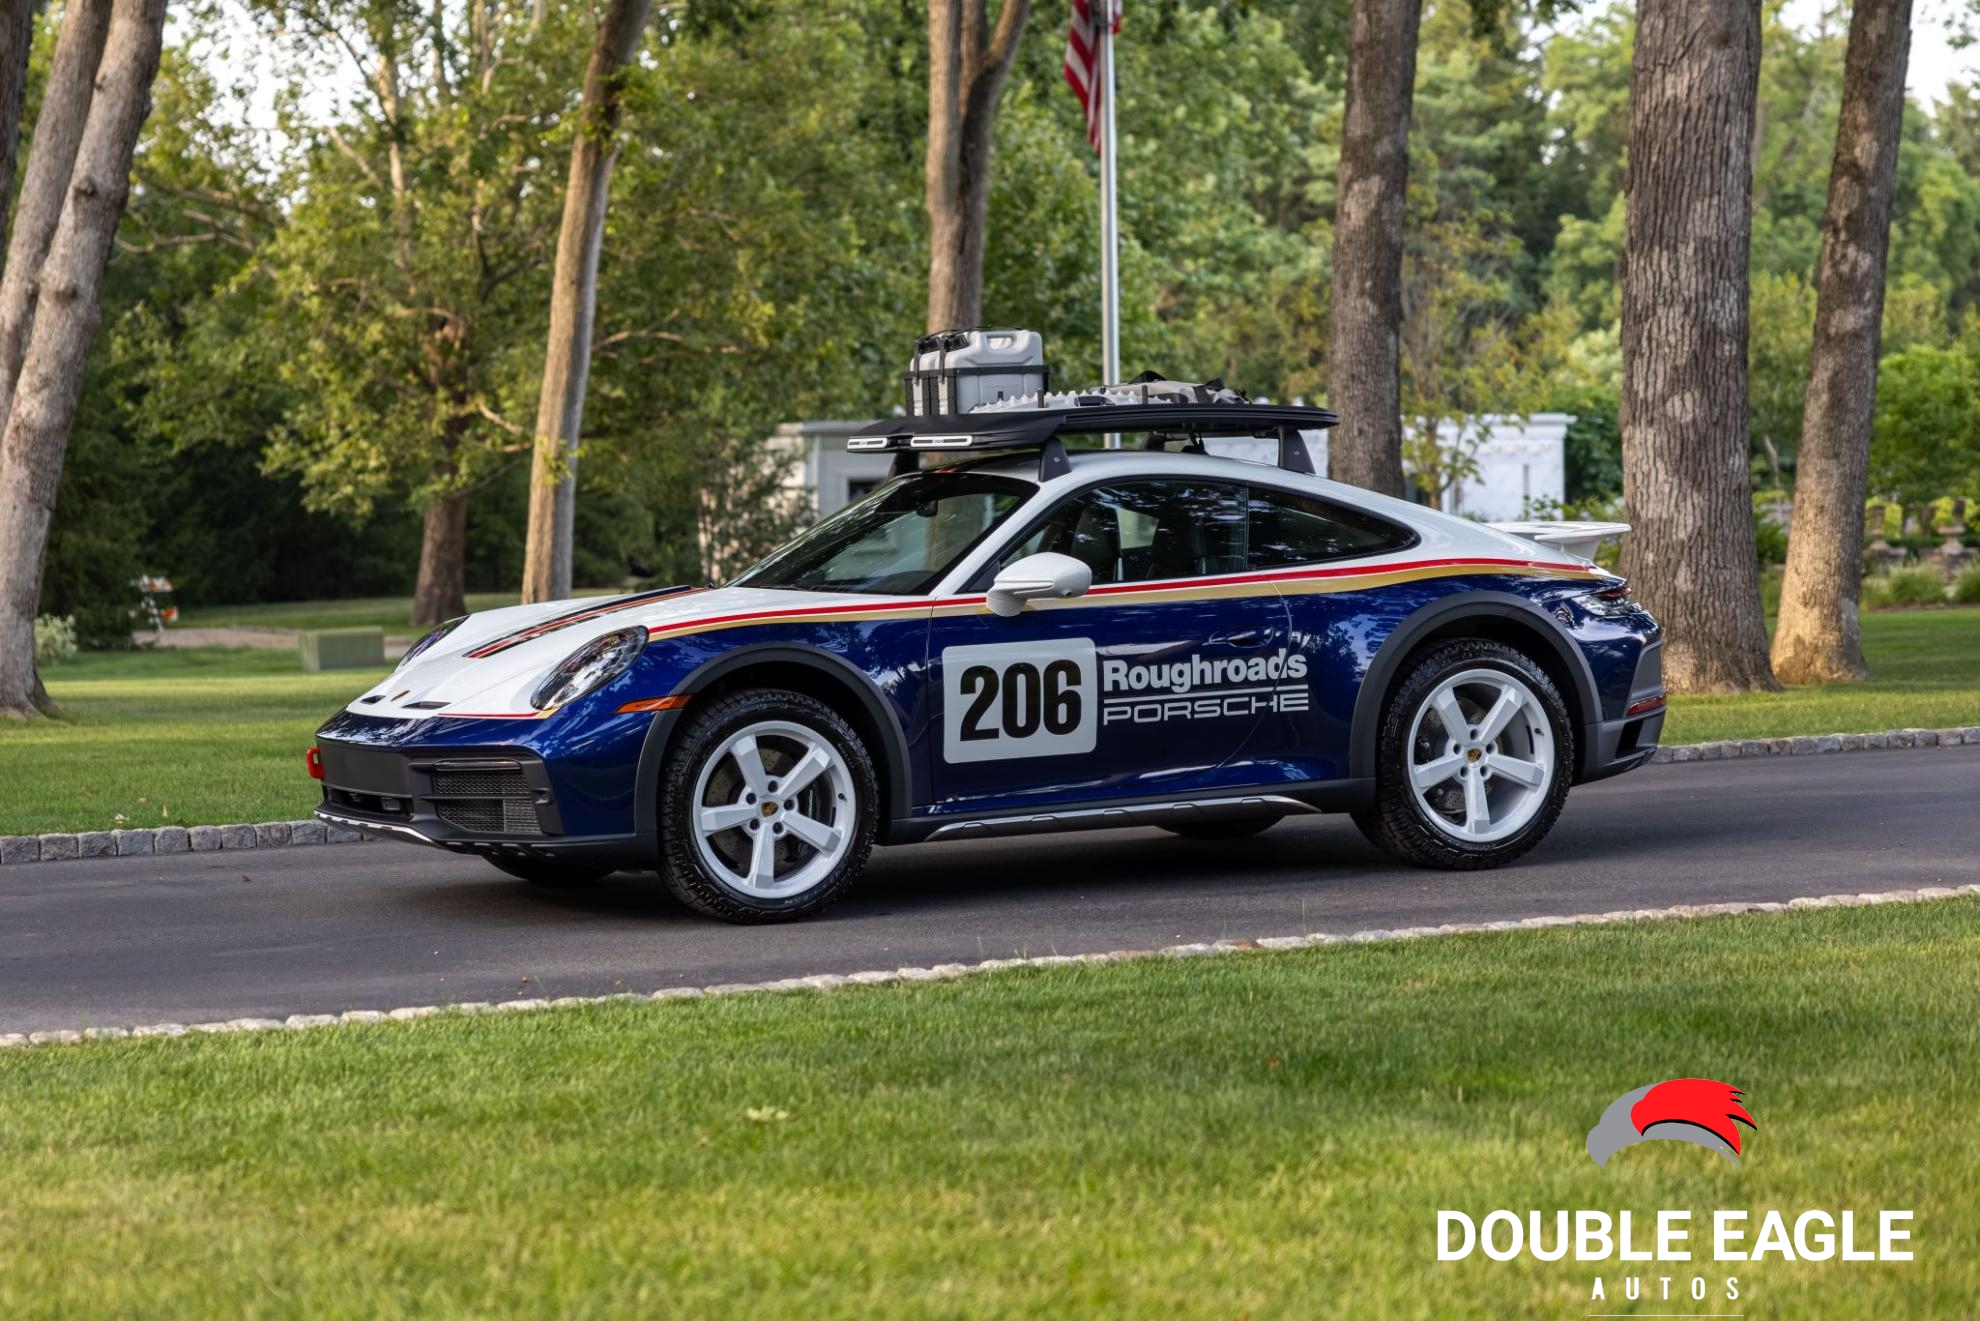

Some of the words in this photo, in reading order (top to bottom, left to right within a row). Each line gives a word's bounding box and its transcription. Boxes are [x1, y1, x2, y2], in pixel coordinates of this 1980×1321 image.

[1103, 648, 1308, 693] Roughroads
[960, 659, 1082, 742] 206
[1103, 692, 1309, 726] PORSCHE
